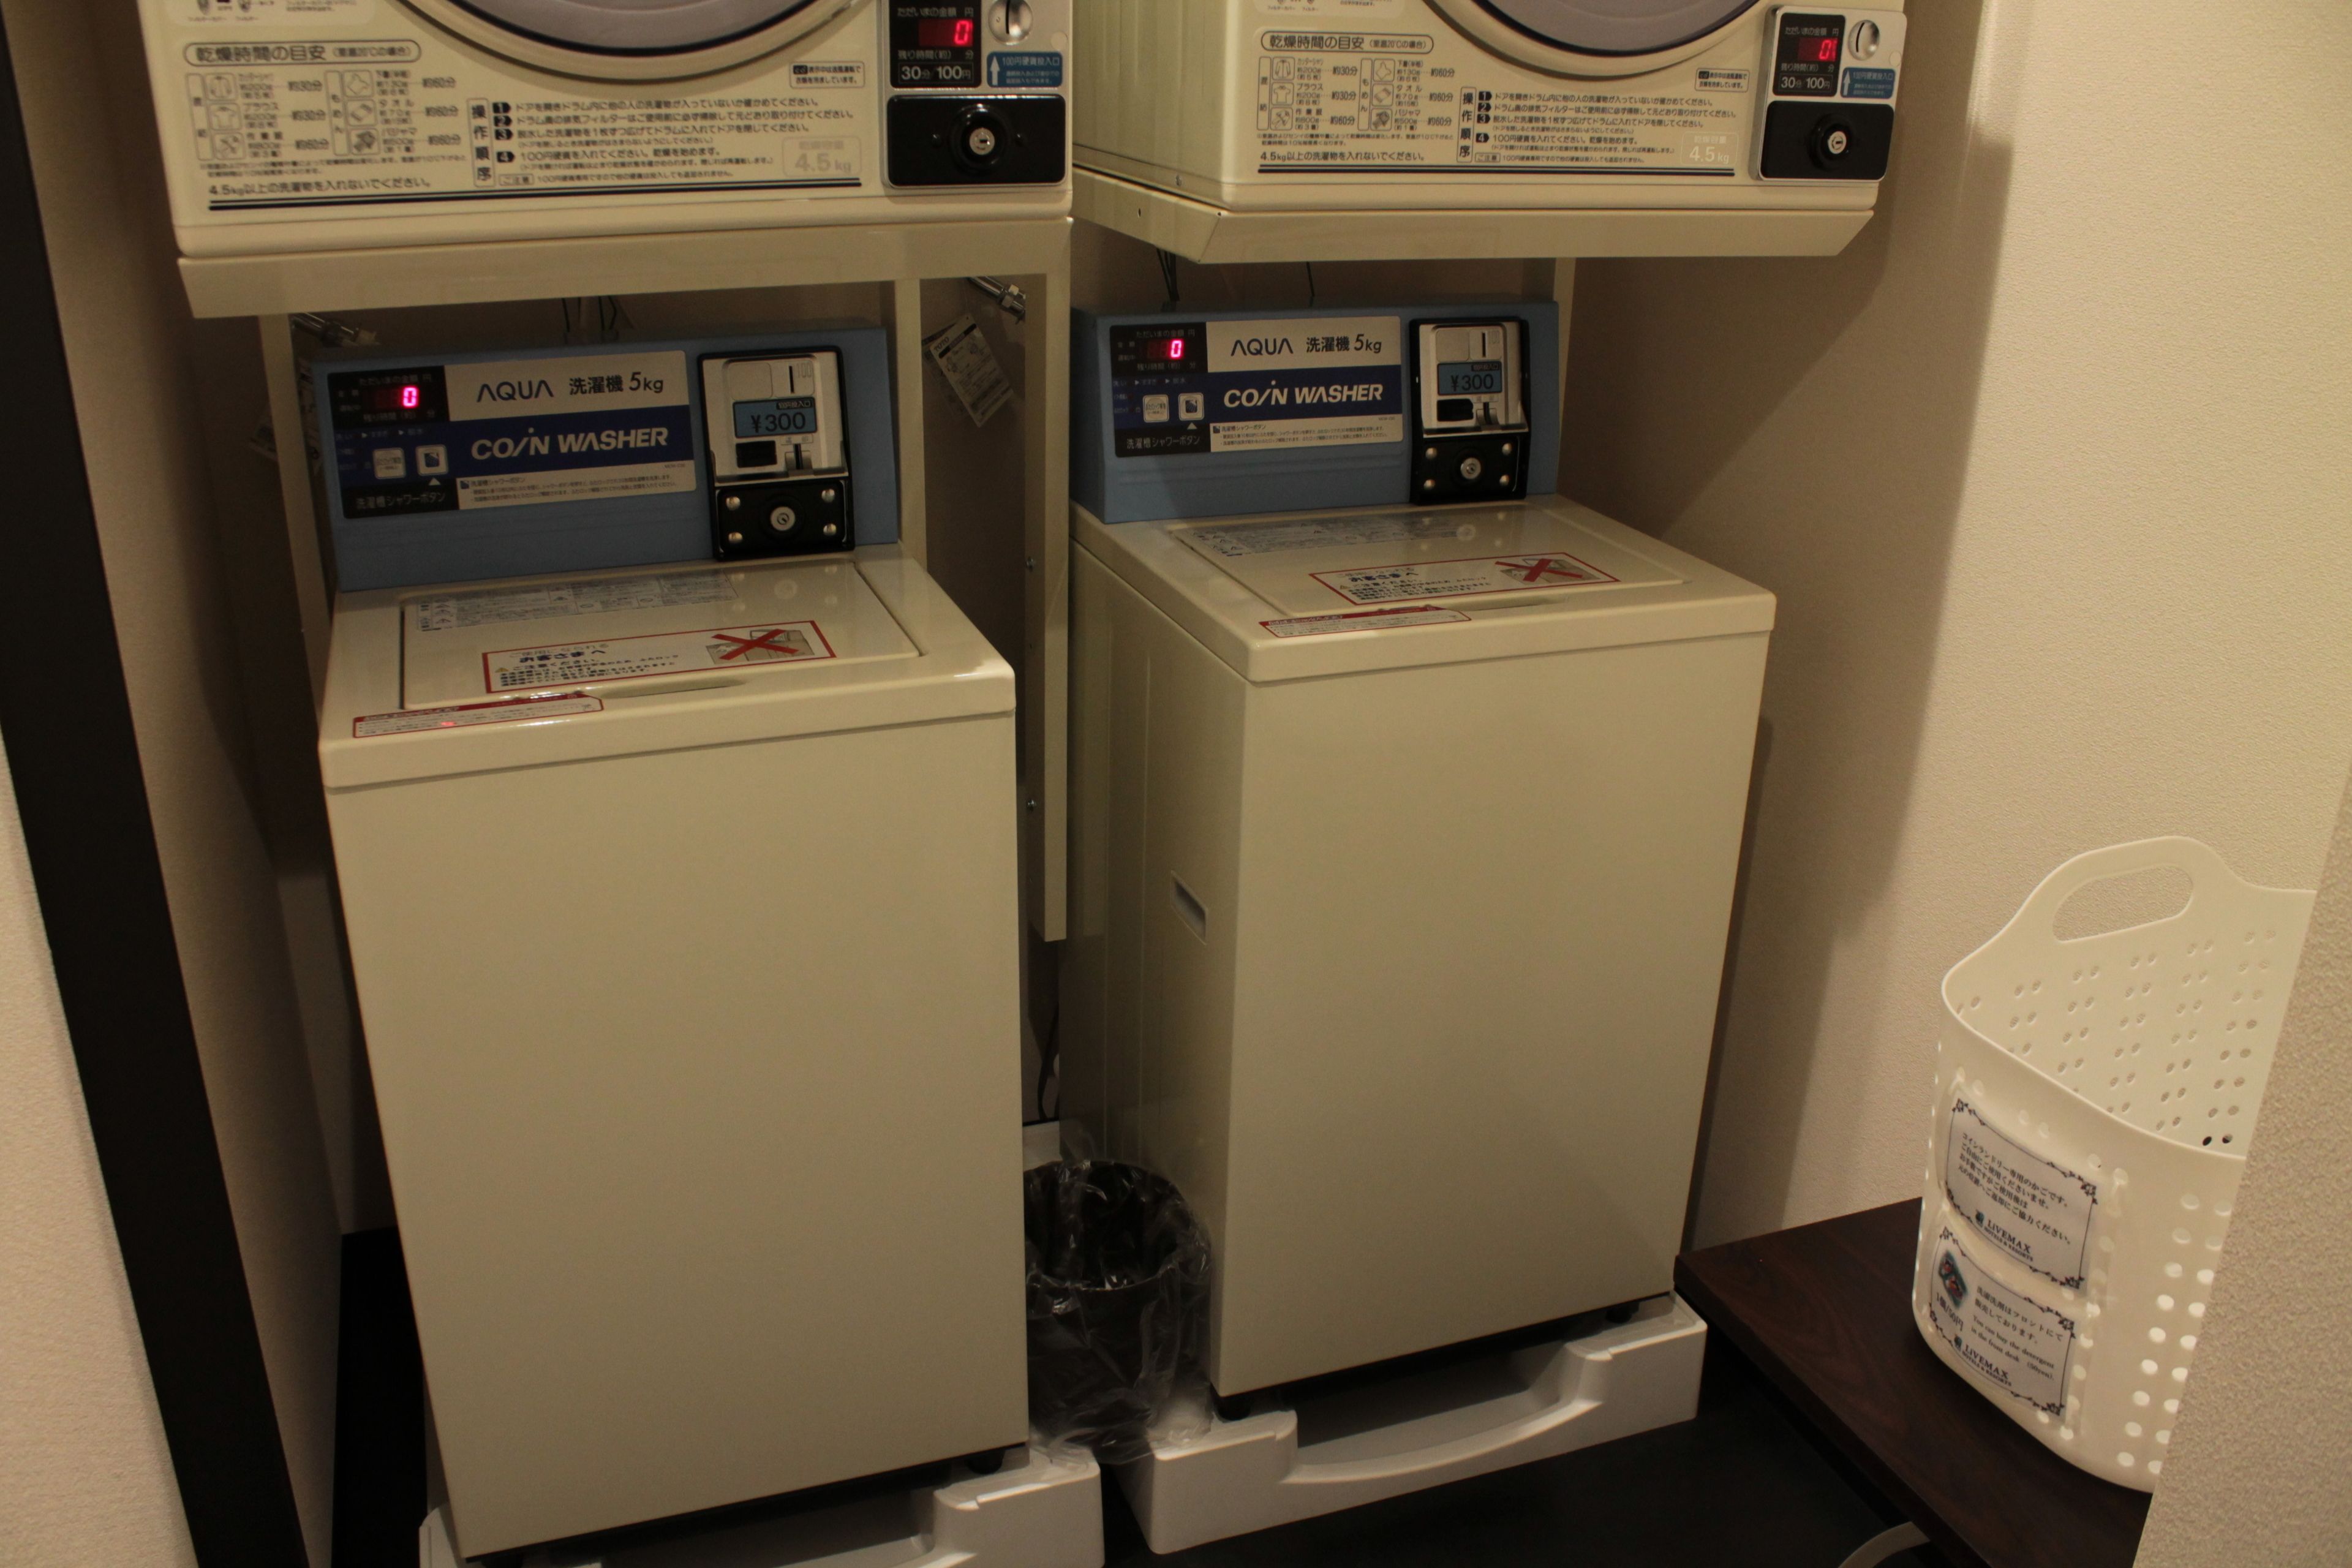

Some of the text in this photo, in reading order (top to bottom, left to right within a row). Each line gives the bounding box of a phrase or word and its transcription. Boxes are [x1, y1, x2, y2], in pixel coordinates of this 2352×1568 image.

[954, 20, 971, 45] 0
[1270, 34, 1365, 50] 乾燥時間の目安
[196, 45, 326, 62] 乾燥時間の目安
[1818, 40, 1832, 61] 0
[1332, 66, 1359, 77] 約30分
[1430, 68, 1455, 78] 約60分
[1331, 91, 1357, 102] 約30分
[1429, 92, 1454, 103] 約60分
[1330, 115, 1355, 126] 約60分
[1427, 116, 1452, 127] 約60分
[1170, 339, 1183, 358] 0
[1231, 337, 1294, 356] AQUA
[1306, 336, 1351, 353] 洗濯機
[477, 380, 554, 402] AQUA
[569, 375, 624, 395] 洗濯機
[1450, 374, 1494, 392] ¥300
[402, 386, 419, 409] 0
[1294, 383, 1384, 404] WASHER
[750, 412, 807, 434] ¥300
[557, 427, 669, 453] WASHER
[1126, 435, 1200, 450] 洗濯槽シャワーボタン
[1988, 1340, 2003, 1354] front
[2004, 1350, 2020, 1363] desk
[2021, 1347, 2055, 1369] detergent
